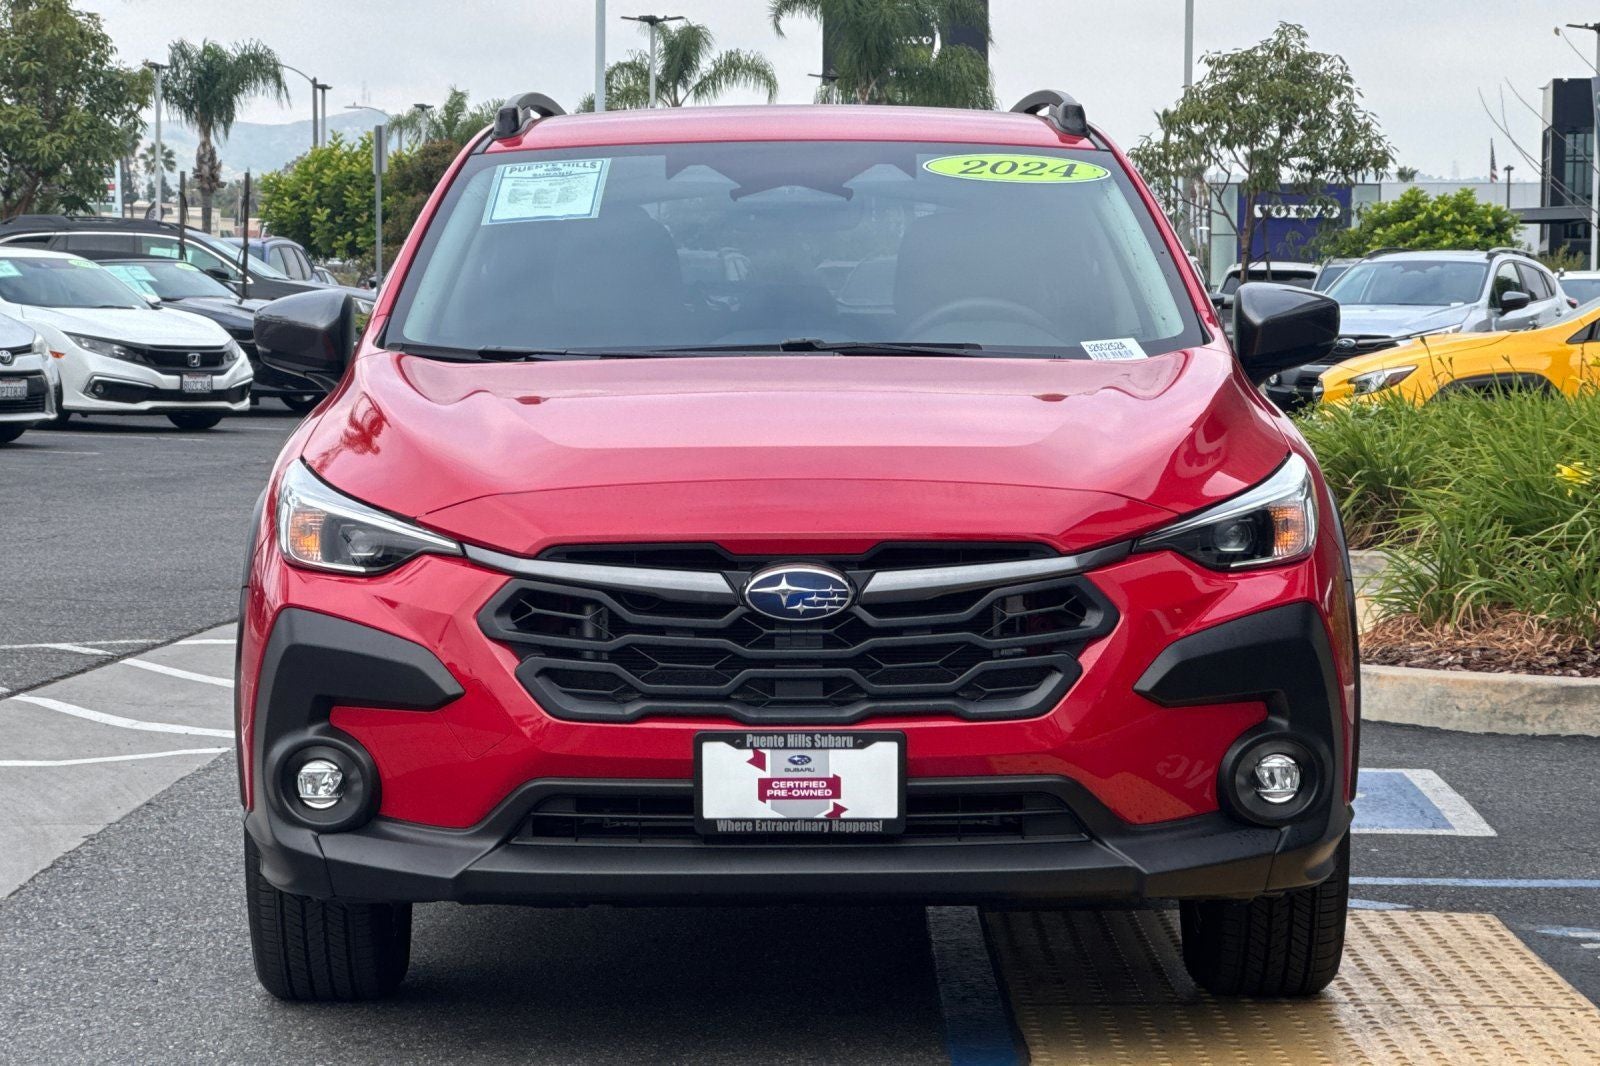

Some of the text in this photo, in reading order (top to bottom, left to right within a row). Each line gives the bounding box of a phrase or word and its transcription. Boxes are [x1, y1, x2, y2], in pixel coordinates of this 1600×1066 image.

[508, 161, 598, 174] PUENTE HILLS
[959, 160, 1079, 178] 2024
[1254, 204, 1341, 218] VOLVO
[747, 733, 854, 747] Puente Hills Subaru
[771, 780, 827, 788] CERTIFIED
[766, 788, 833, 797] PRE-OWNED
[717, 820, 883, 833] Where Extraordinary Happens!
